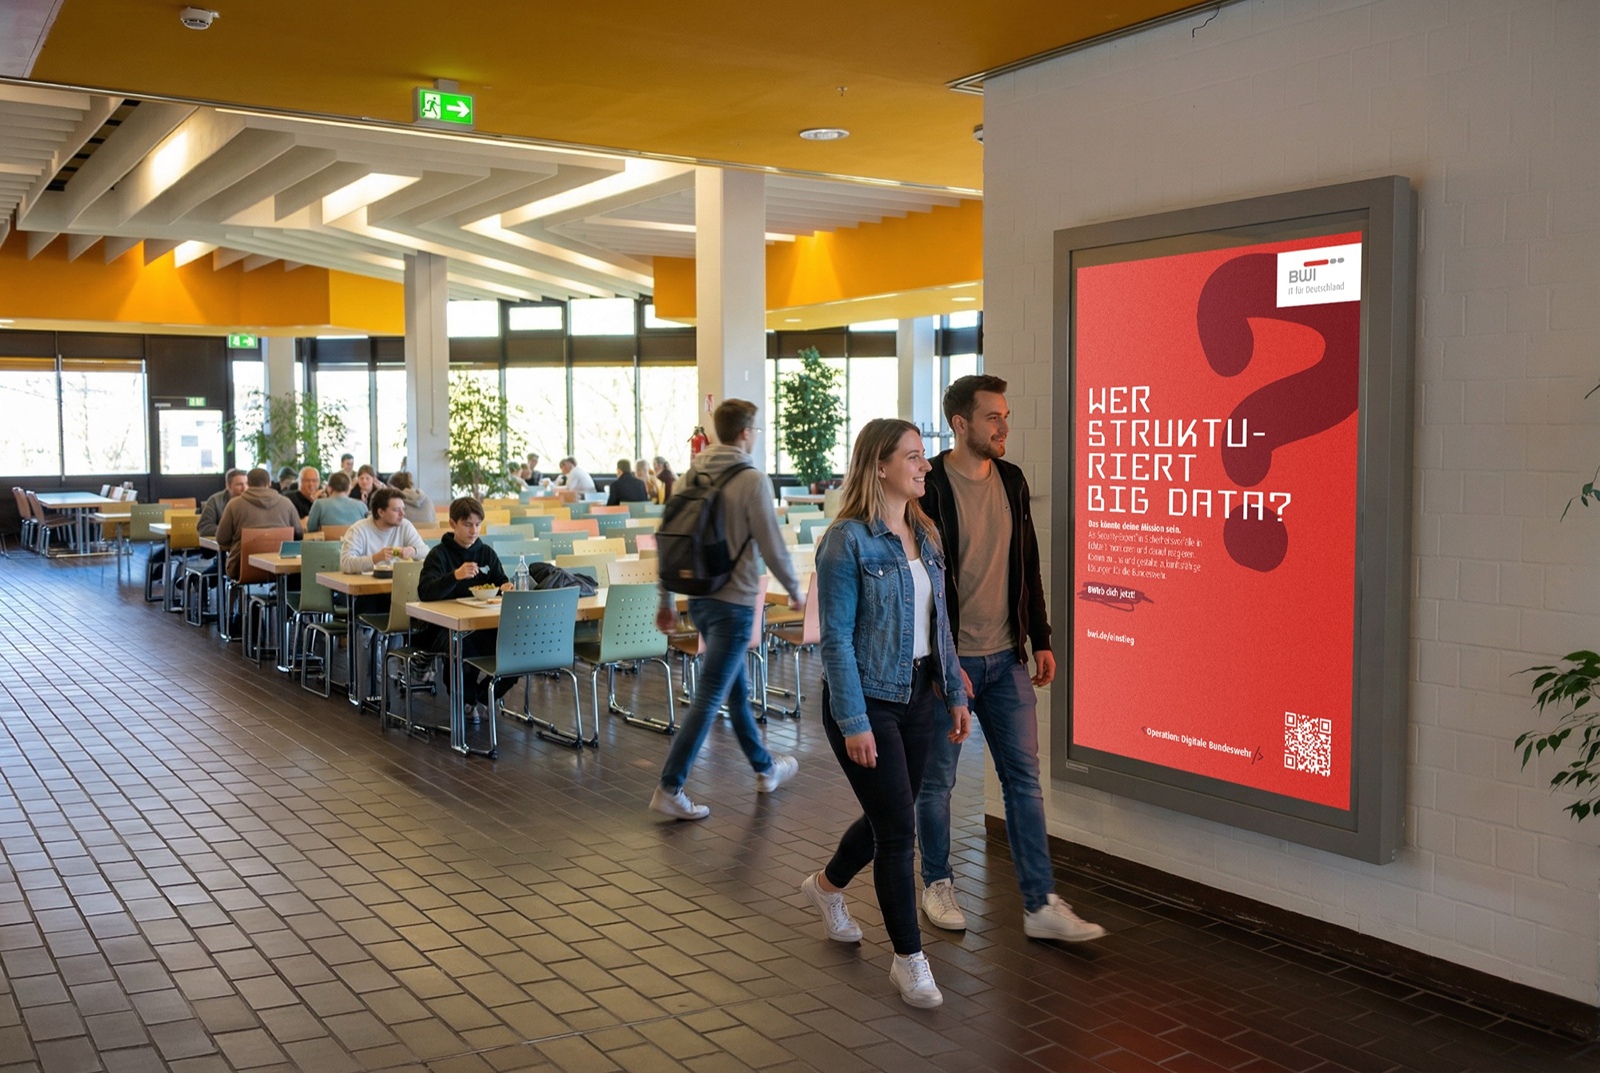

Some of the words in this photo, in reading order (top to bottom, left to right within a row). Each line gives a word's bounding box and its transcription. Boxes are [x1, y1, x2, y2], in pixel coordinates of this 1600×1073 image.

[1288, 268, 1316, 284] BWI
[1288, 287, 1294, 295] IT
[1295, 286, 1304, 295] für
[1306, 281, 1345, 294] Deutschland
[1088, 385, 1150, 414] WER
[1088, 418, 1266, 448] STRUKTU-
[1088, 452, 1197, 482] RIERT
[1088, 485, 1149, 515] BIG
[1168, 488, 1292, 522] DATA?
[1088, 519, 1099, 528] Das
[1100, 520, 1121, 530] könnte
[1122, 522, 1140, 531] deine
[1141, 523, 1165, 533] Mission
[1166, 525, 1181, 534] sein.
[1106, 587, 1119, 597] dich
[1119, 589, 1136, 600] jetzt!
[1087, 629, 1135, 646] bwi.de/einstieg
[1181, 734, 1207, 748] Digitale
